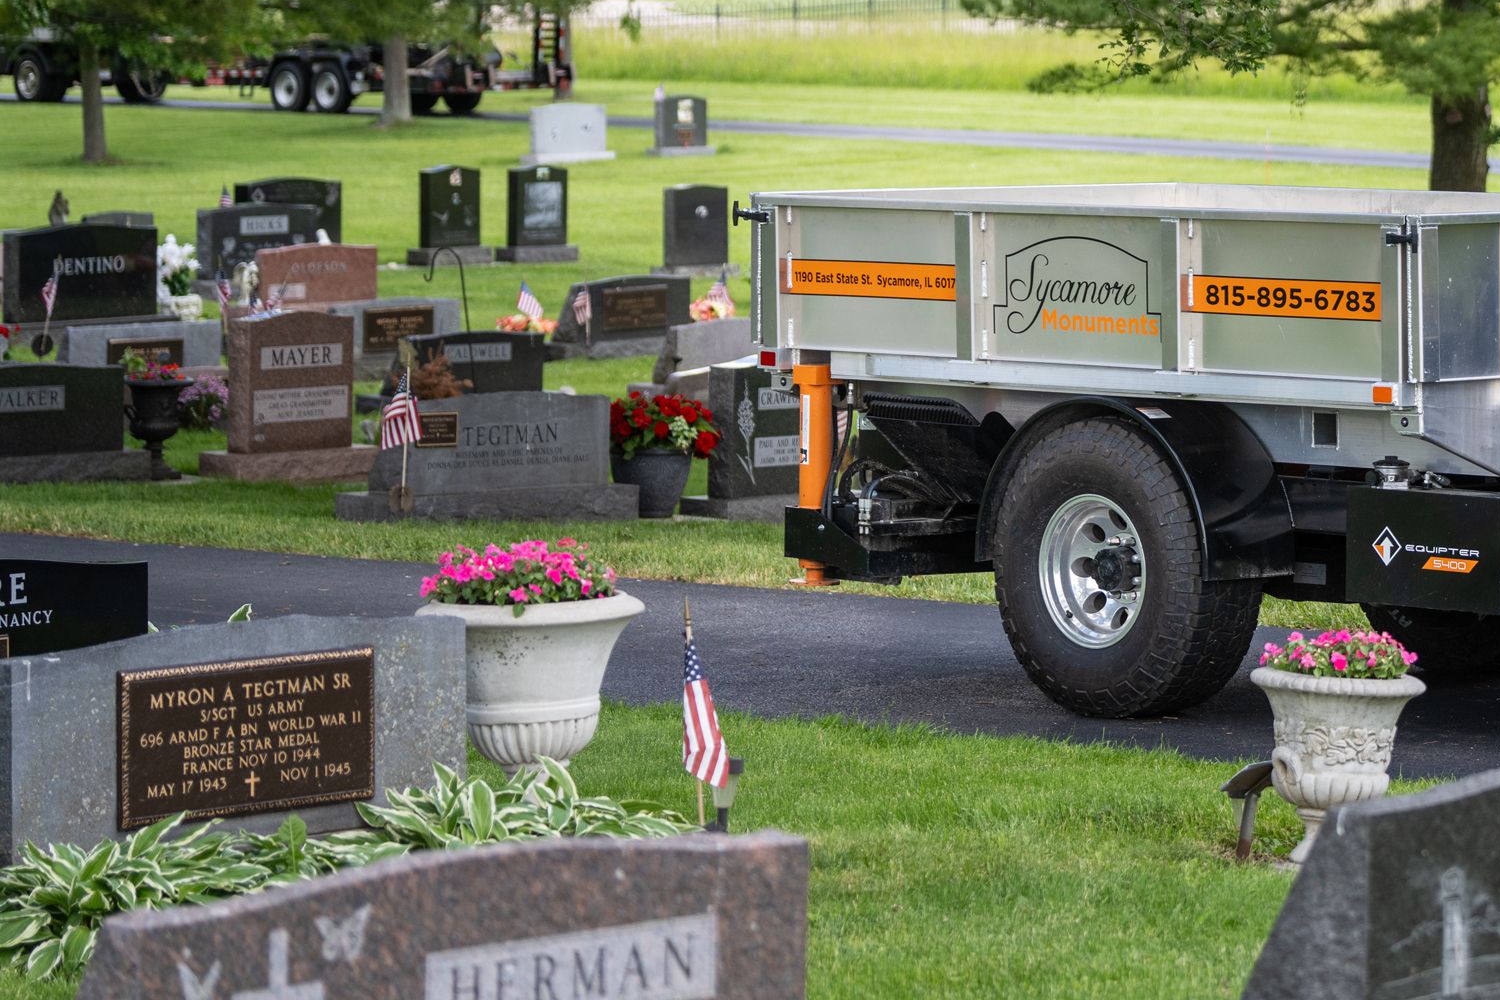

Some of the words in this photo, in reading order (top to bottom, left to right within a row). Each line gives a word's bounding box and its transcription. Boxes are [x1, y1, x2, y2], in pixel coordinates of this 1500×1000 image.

[246, 218, 283, 231] HICKS
[292, 261, 348, 274] OLOFSON
[795, 271, 813, 283] 1190
[816, 272, 834, 284] East
[836, 273, 859, 285] State
[861, 274, 873, 286] St.
[877, 275, 922, 290] Sycamore,
[924, 278, 933, 288] IL
[1007, 254, 1137, 335] Sycamore
[1206, 284, 1376, 313] 815-895-6783
[1042, 308, 1160, 337] Monuments
[271, 346, 332, 367] MAYER
[463, 423, 559, 447] TEGTMAN
[776, 439, 789, 448] AND
[1405, 544, 1480, 557] EQUIPTER
[1433, 560, 1467, 571] 5400
[150, 687, 215, 709] MYRON
[223, 684, 235, 702] A
[242, 675, 325, 699] TEGTMAN
[333, 672, 351, 690] SR
[201, 706, 237, 722] S/SGT
[247, 704, 263, 717] US
[268, 699, 305, 716] ARMY
[140, 732, 164, 748] 696
[169, 728, 208, 745] ARMD
[213, 727, 220, 740] F
[226, 725, 236, 738] A
[240, 722, 258, 736] BN
[268, 716, 315, 732] WORLD
[320, 712, 347, 727] WAR
[352, 710, 361, 724] II
[183, 741, 235, 759] BRONZE
[240, 737, 272, 753] STAR
[278, 732, 320, 748] MEDAL
[183, 757, 234, 775] FRANCE
[239, 753, 268, 769] NOV
[274, 751, 287, 765] 10
[293, 747, 321, 763] 1944
[147, 782, 175, 799] MAY
[182, 780, 193, 795] 17
[200, 777, 227, 793] 1943
[280, 766, 309, 782] NOV
[314, 766, 319, 778] 1
[324, 762, 351, 777] 1945
[451, 932, 695, 1000] HERMAN
